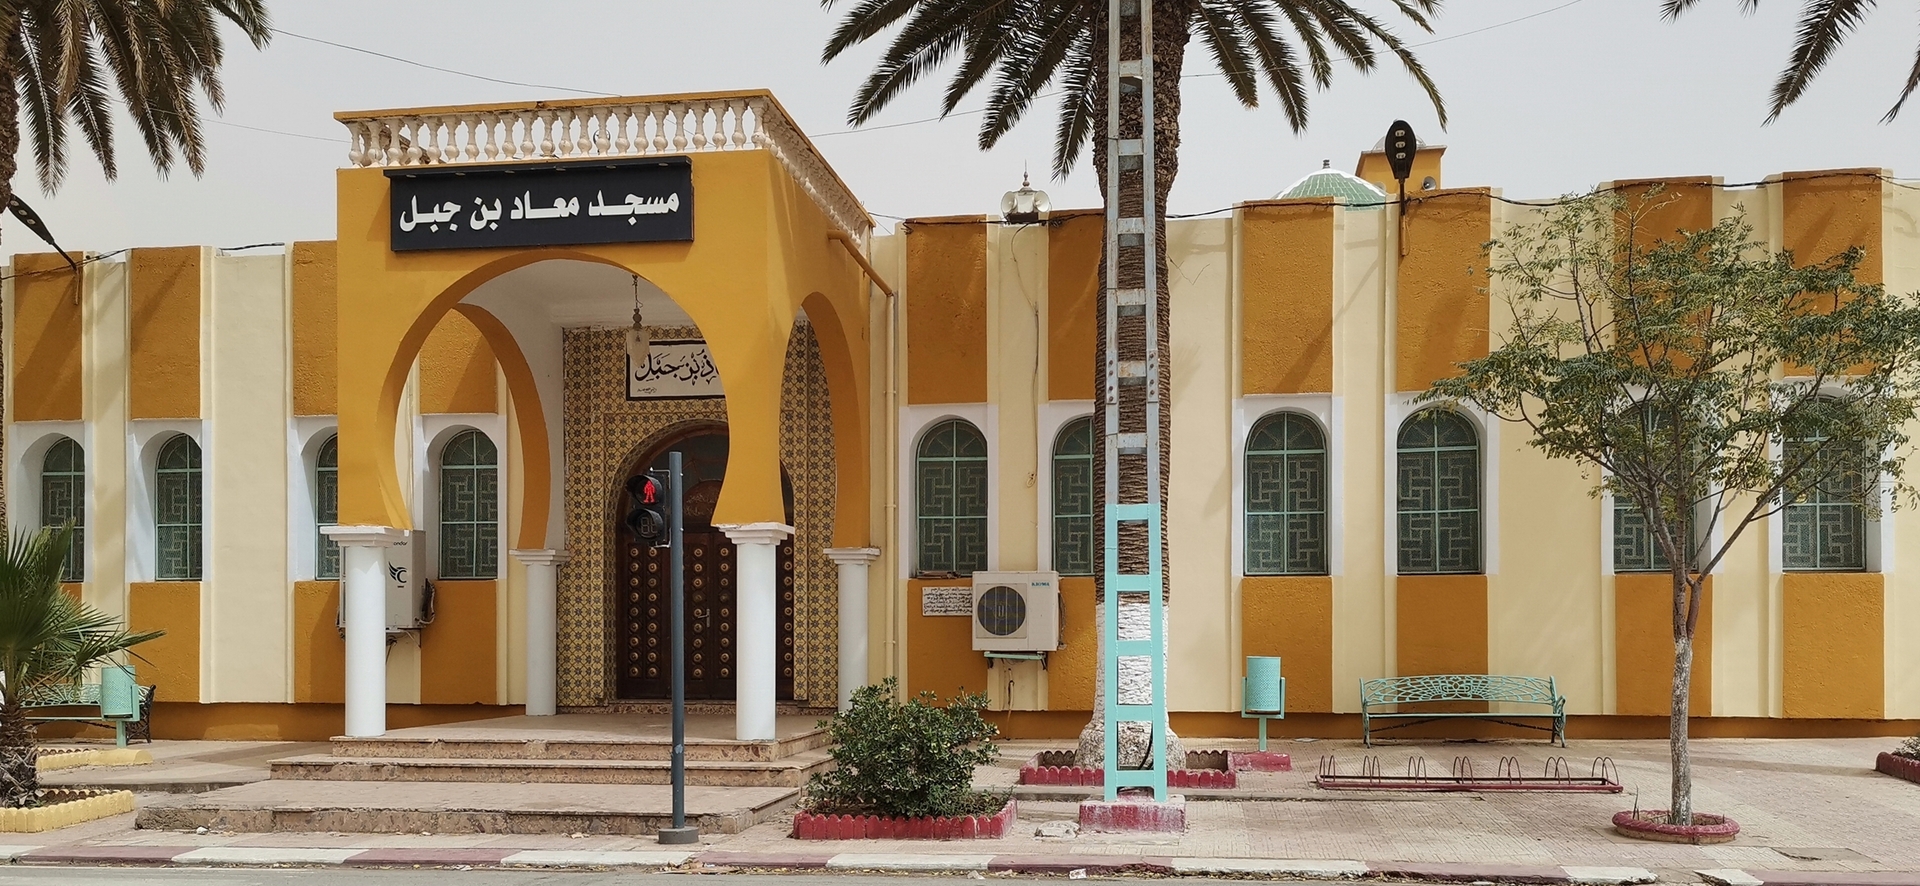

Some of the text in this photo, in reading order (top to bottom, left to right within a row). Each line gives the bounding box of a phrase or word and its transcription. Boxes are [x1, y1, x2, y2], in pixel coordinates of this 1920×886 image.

[399, 190, 680, 233] مسجد معاد بن جبل
